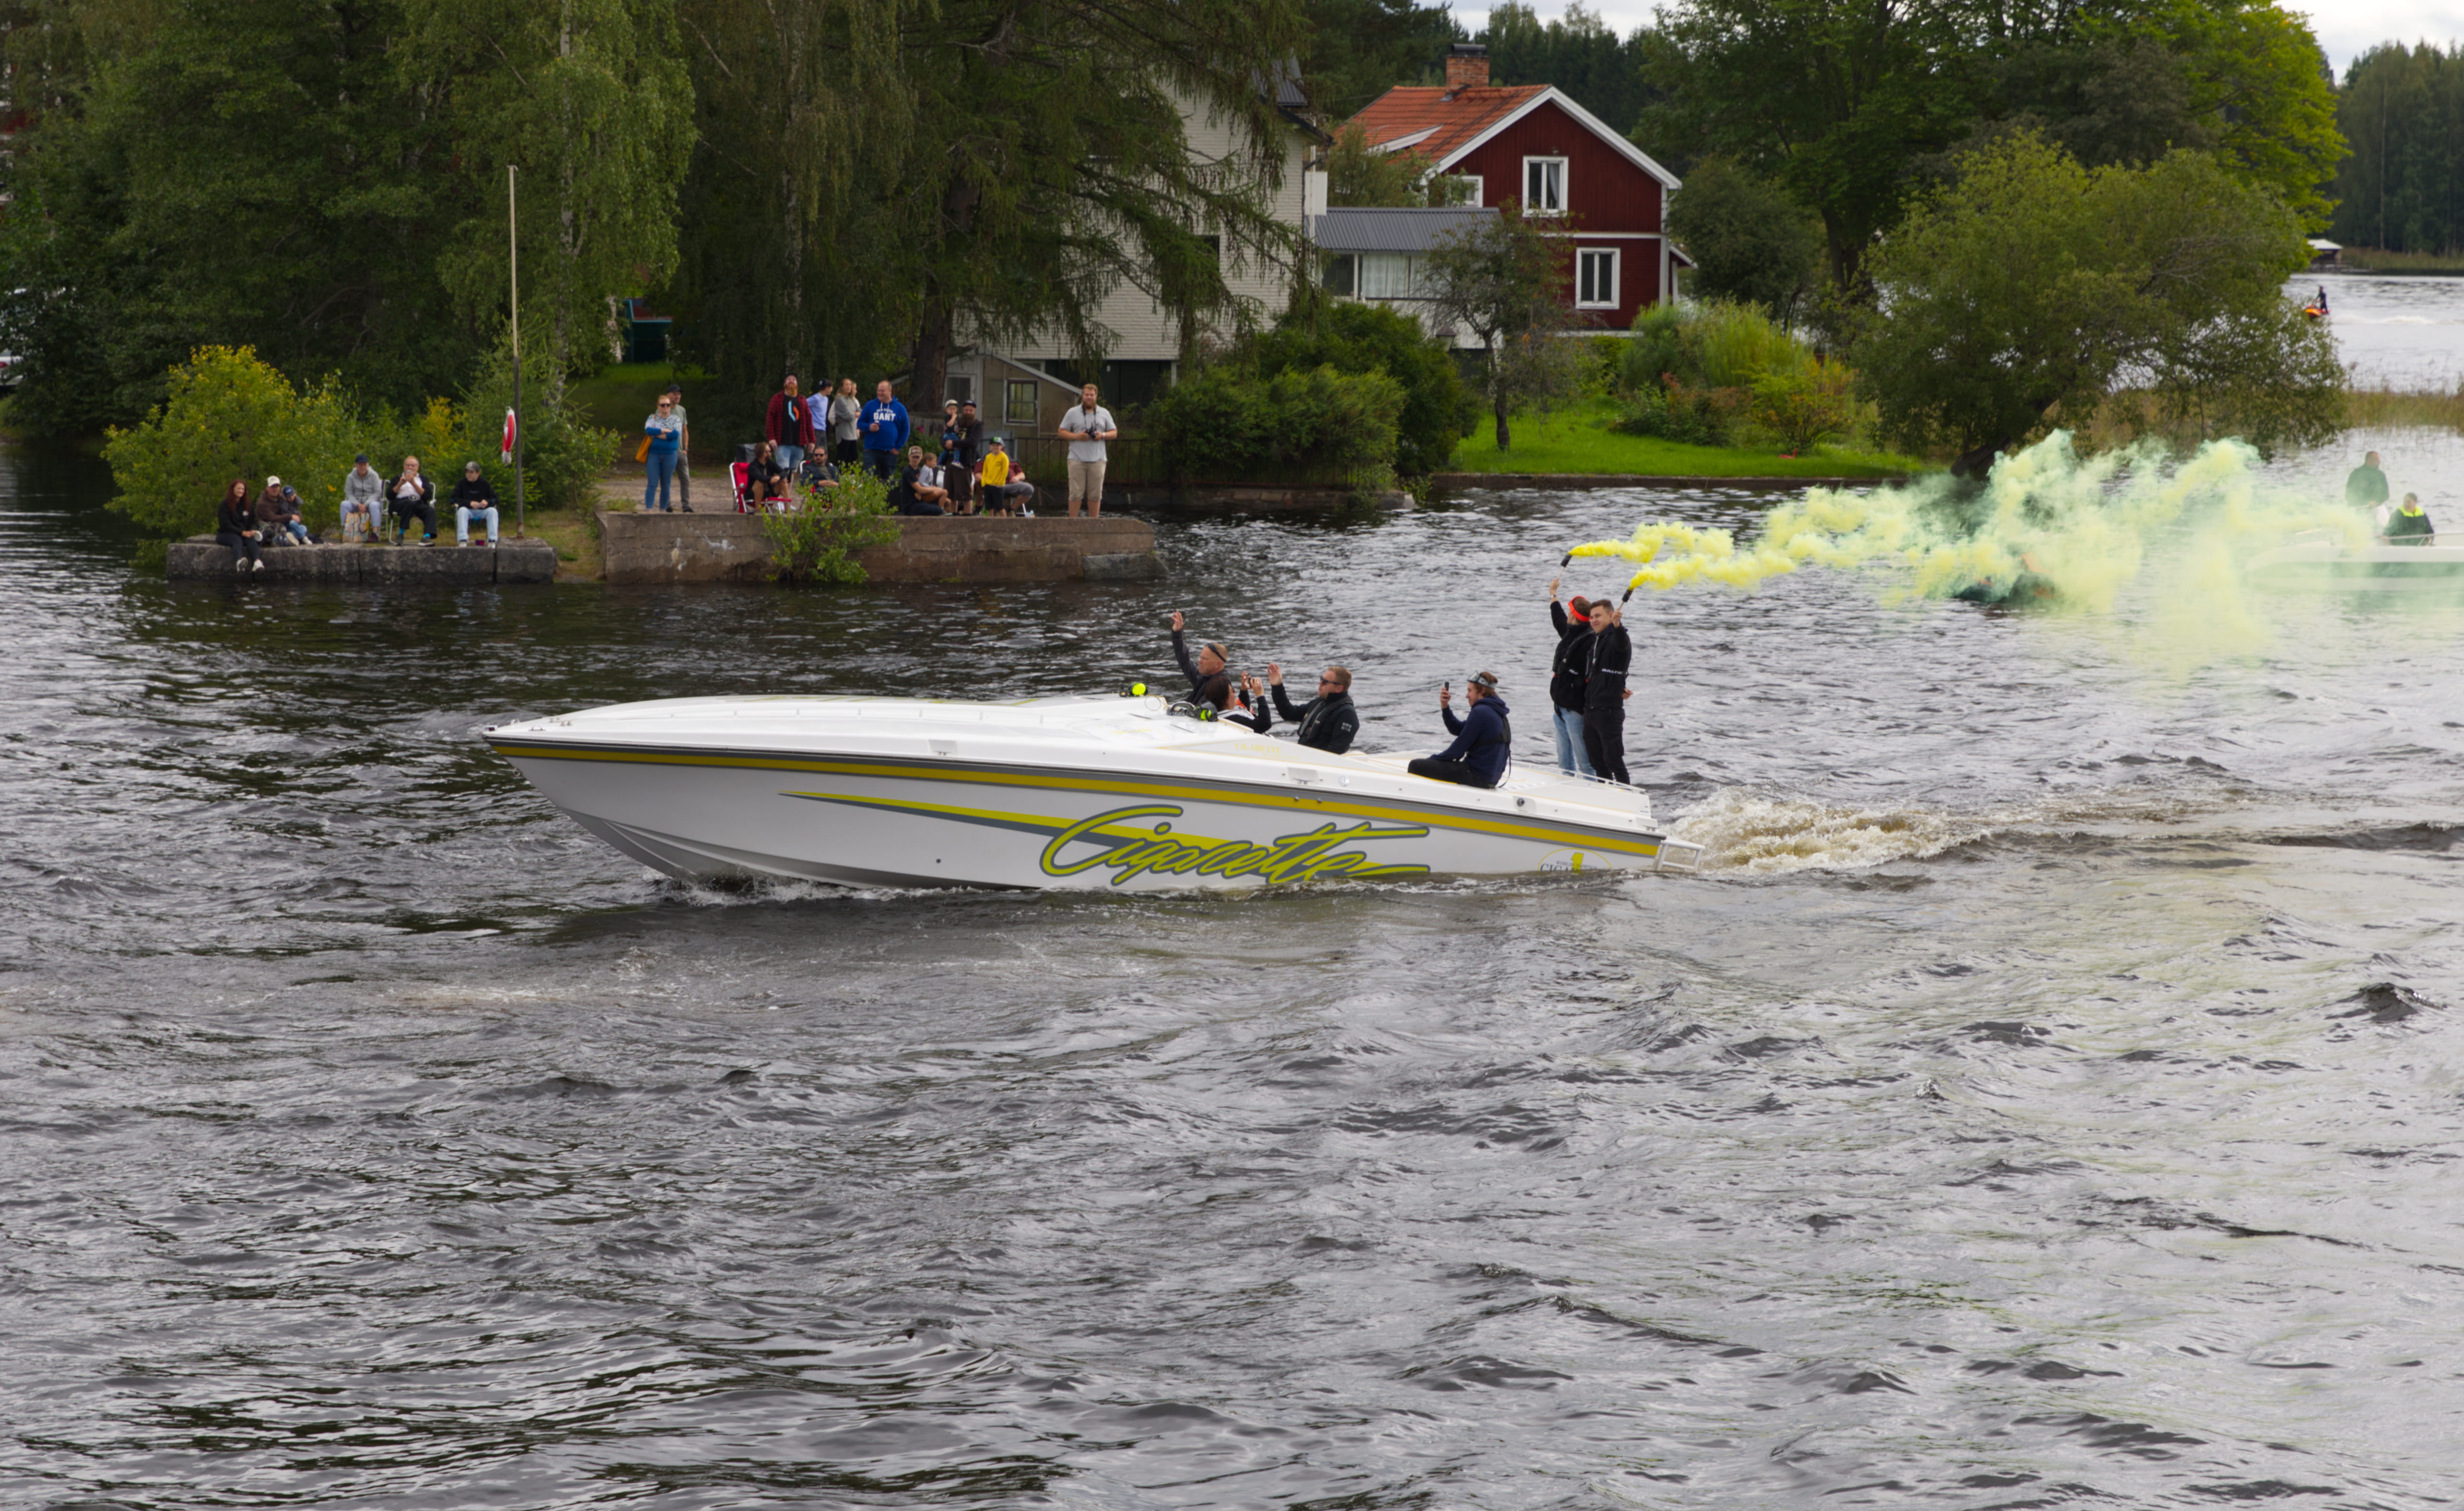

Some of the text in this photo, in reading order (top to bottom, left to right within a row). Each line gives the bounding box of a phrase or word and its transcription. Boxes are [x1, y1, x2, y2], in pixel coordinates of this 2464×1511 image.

[873, 412, 896, 422] GANT
[1235, 743, 1282, 754] CIGARETTE
[1039, 804, 1430, 886] Cigarette
